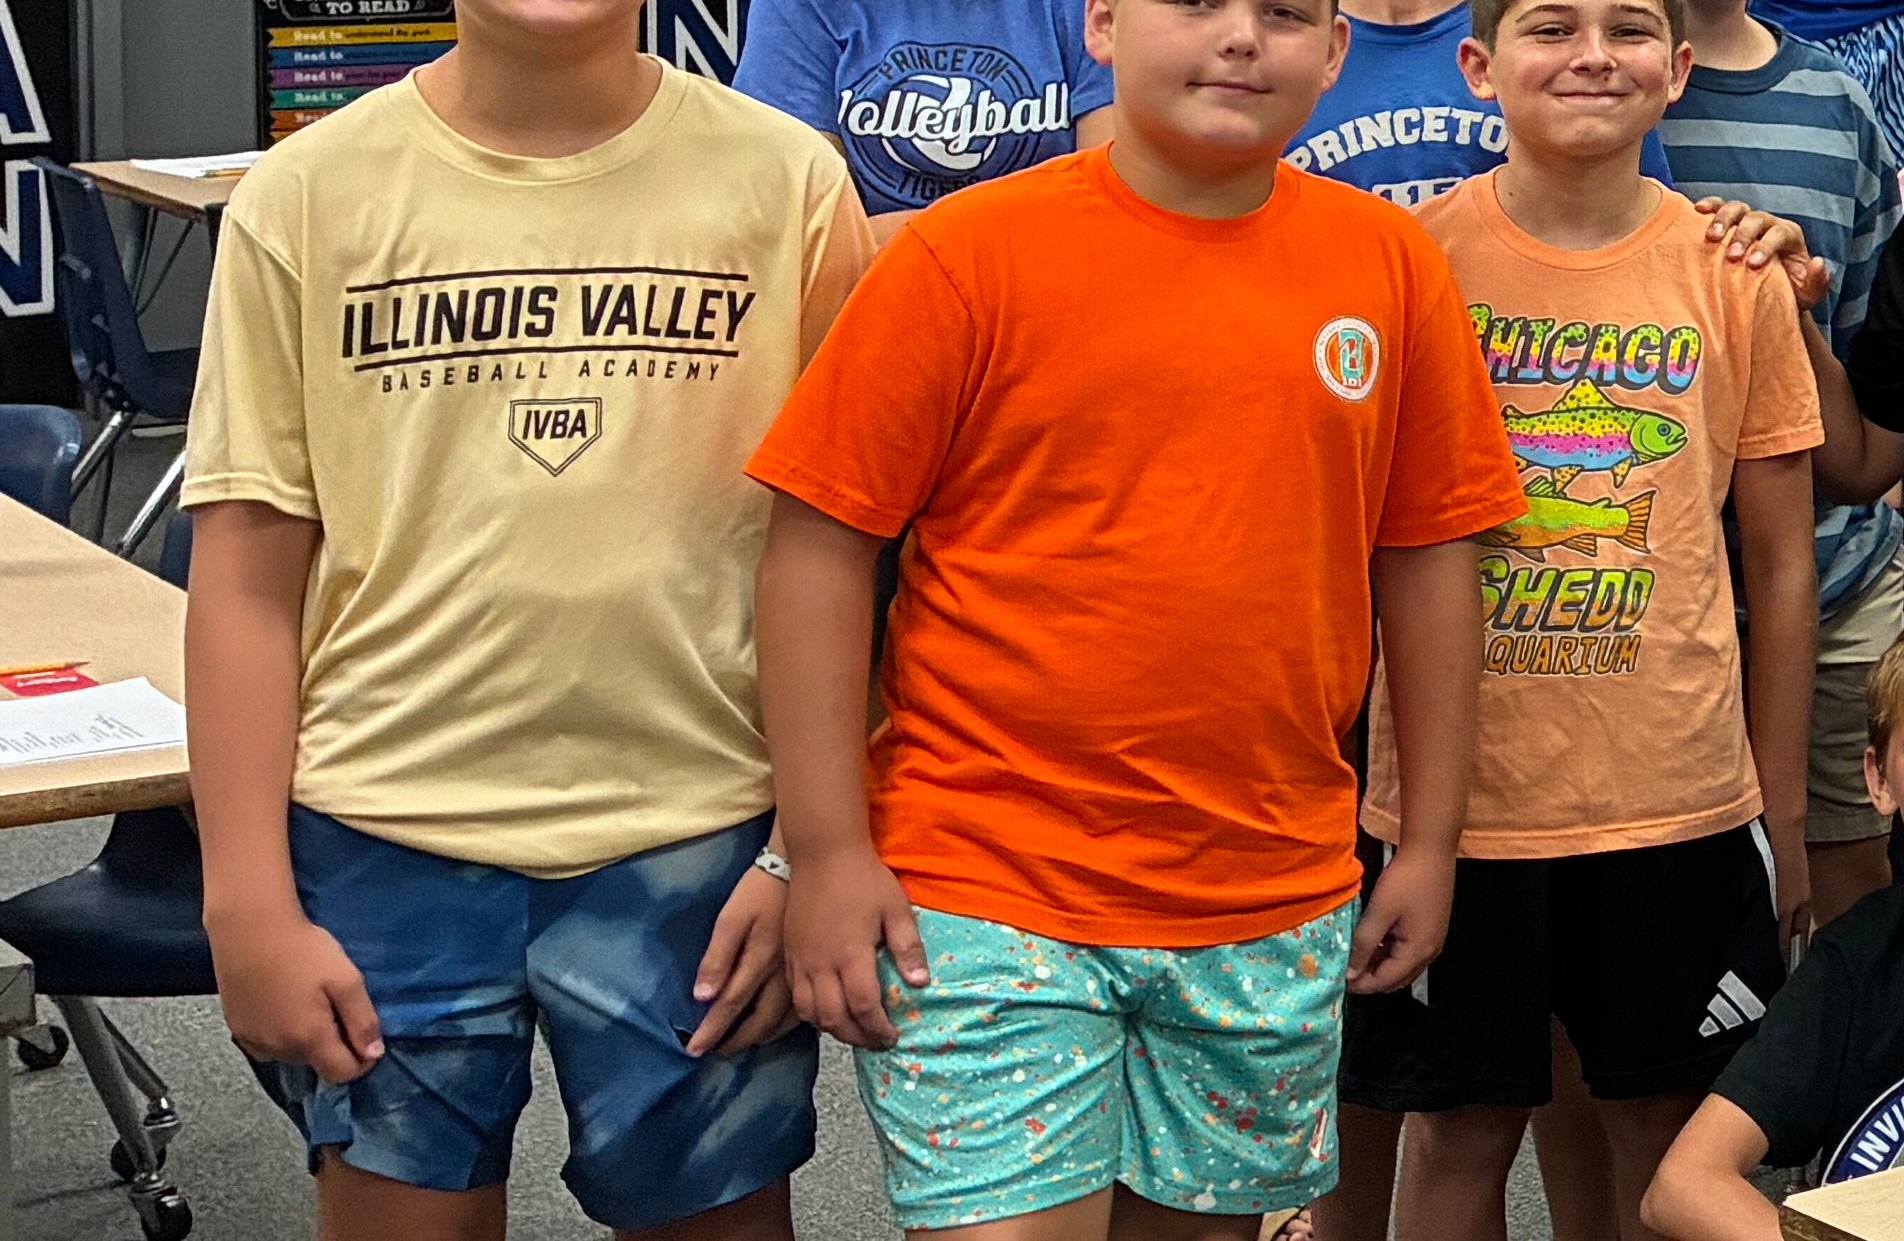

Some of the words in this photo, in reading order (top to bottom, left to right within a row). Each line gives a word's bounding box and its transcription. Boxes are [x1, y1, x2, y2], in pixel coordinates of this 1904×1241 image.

[326, 2, 353, 15] TO
[359, 0, 410, 13] READ
[878, 44, 1009, 82] PRINCETON
[1283, 106, 1509, 172] PRINCETO
[342, 286, 556, 358] ILLINOIS
[581, 283, 756, 343] VALLEY
[382, 362, 549, 393] BASEBALL
[579, 360, 721, 382] ACADEMY
[522, 410, 589, 440] IVBA
[1479, 555, 1656, 634] SHEDD
[1486, 632, 1642, 676] QUARIUM
